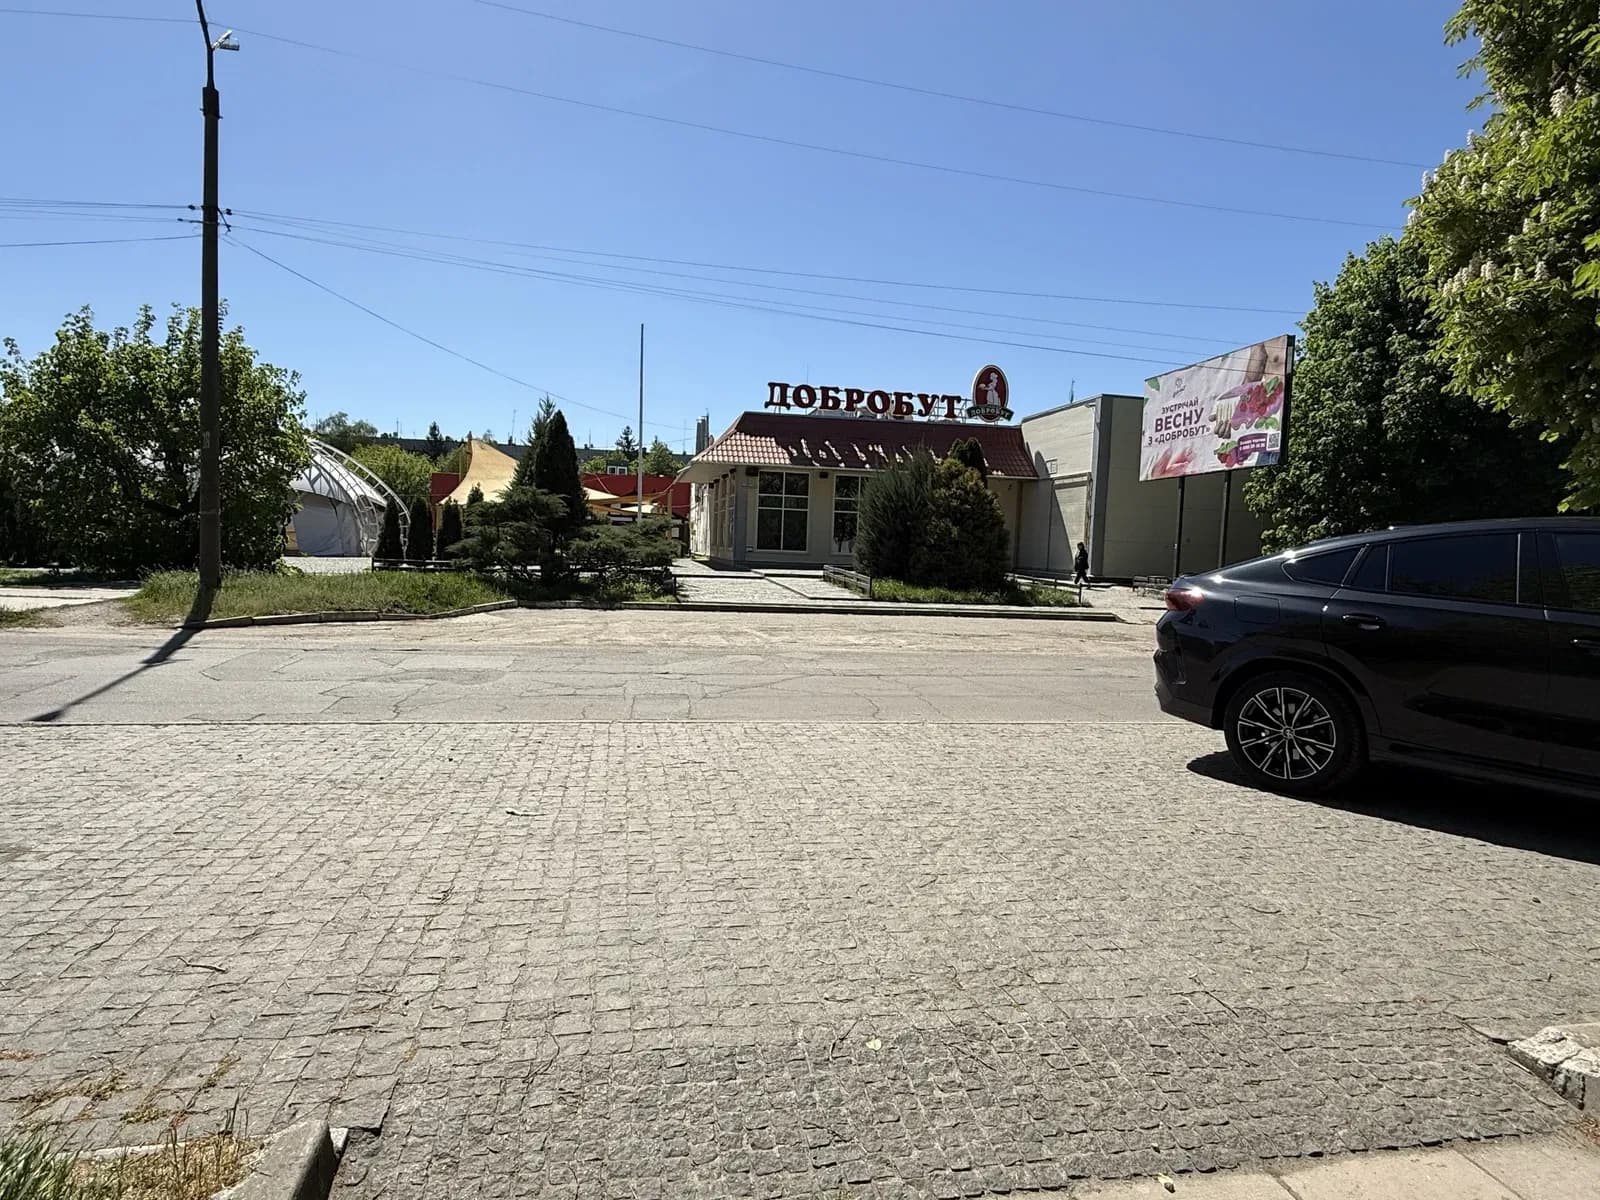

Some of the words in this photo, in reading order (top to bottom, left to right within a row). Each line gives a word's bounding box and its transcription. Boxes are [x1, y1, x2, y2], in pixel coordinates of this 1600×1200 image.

[764, 382, 962, 419] ДОБРОБУТ
[1161, 397, 1199, 415] ЗУСТРІЧАЙ
[1155, 407, 1204, 432] ВЕСНУ
